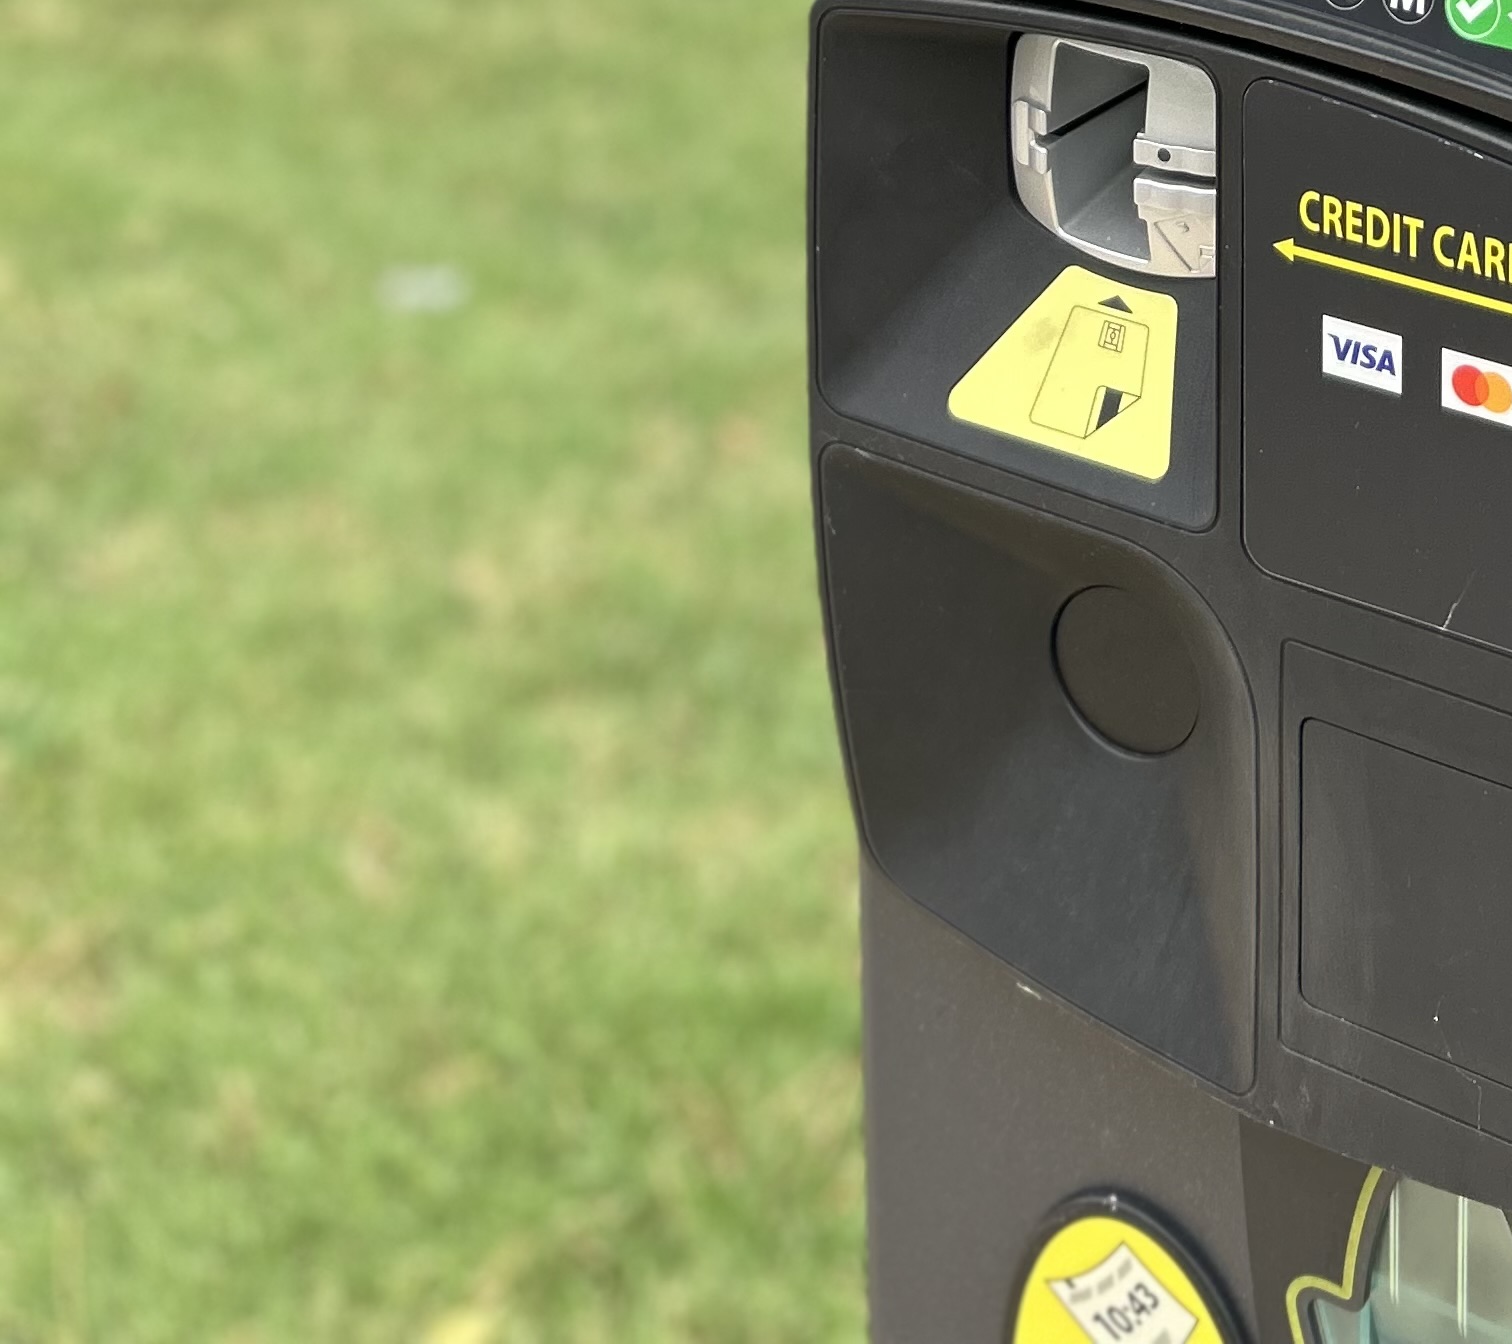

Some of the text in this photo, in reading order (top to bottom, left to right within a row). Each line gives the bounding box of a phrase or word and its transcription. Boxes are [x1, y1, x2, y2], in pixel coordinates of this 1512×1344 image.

[1299, 189, 1424, 258] CREDIT
[1327, 333, 1397, 376] VISA
[1093, 1281, 1160, 1341] 10:43
